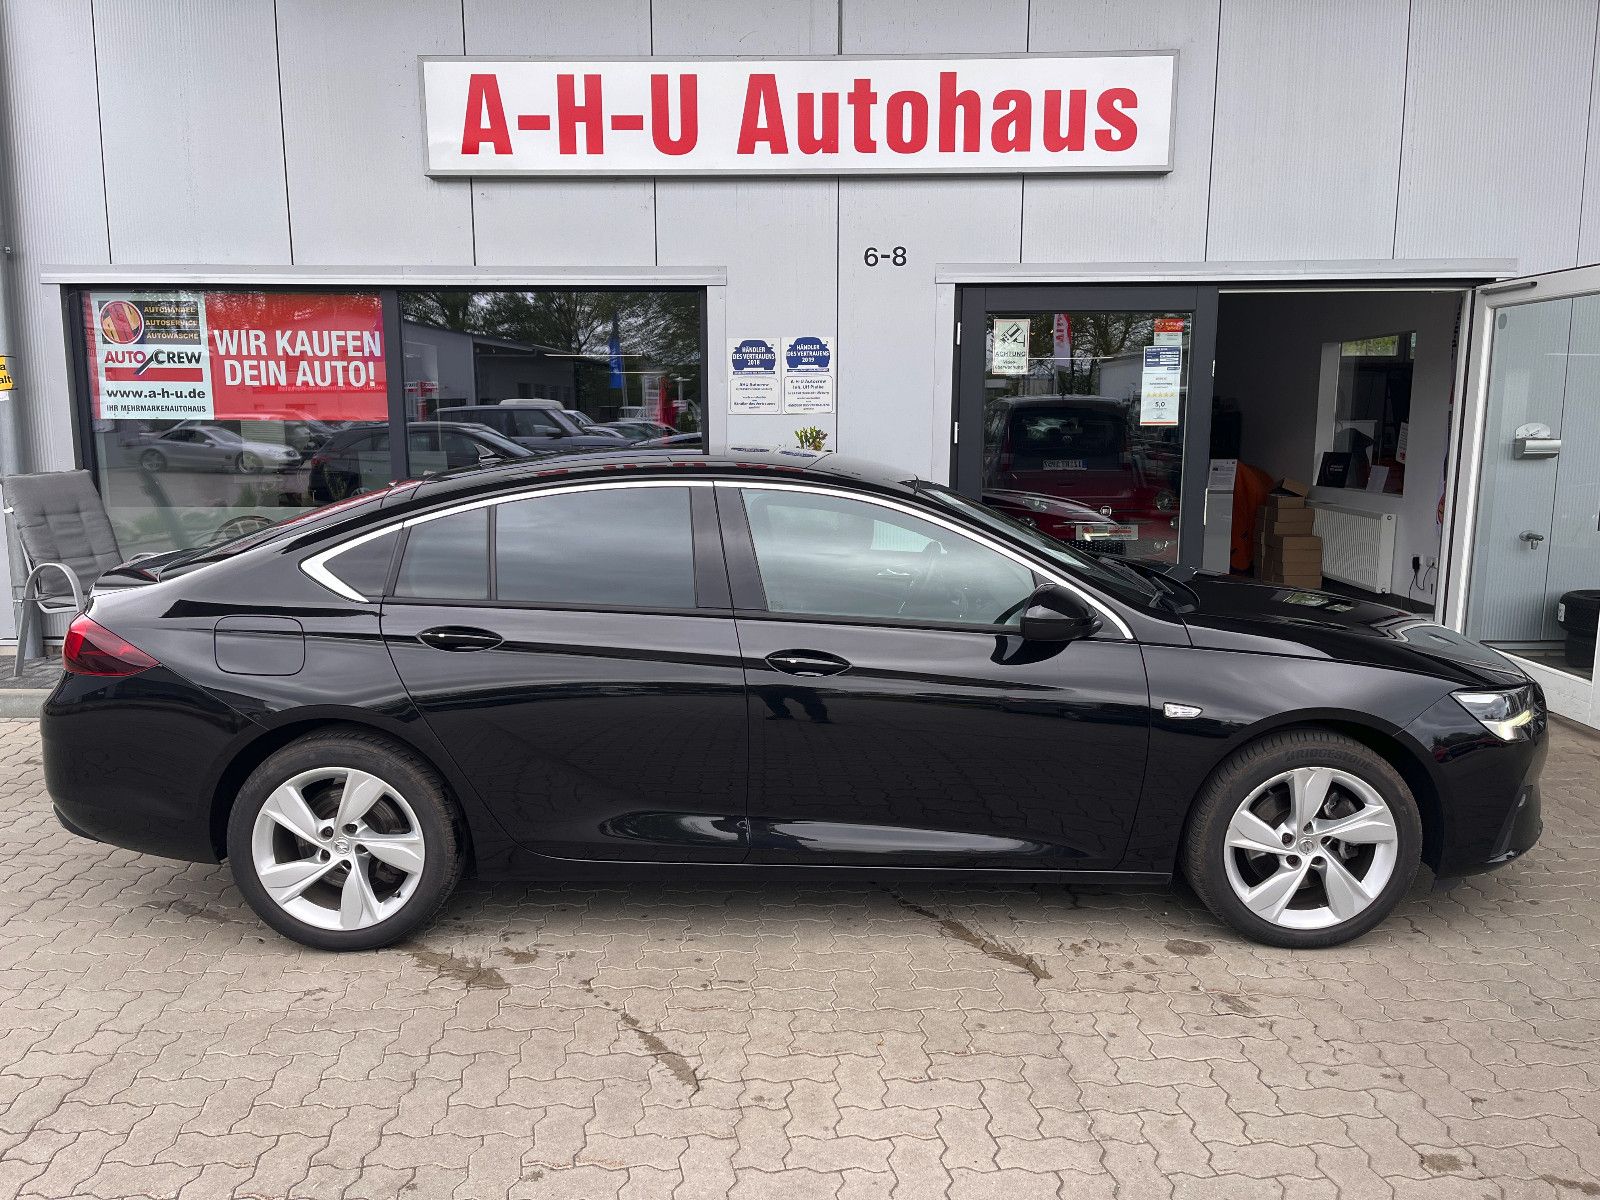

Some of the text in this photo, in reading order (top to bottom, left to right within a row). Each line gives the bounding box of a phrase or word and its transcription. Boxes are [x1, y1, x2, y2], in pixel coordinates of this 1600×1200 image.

[461, 71, 1138, 156] A-H-U Autohaus
[864, 246, 907, 267] 6-8
[212, 329, 382, 357] WIR KAUFEN
[741, 345, 766, 353] HÄNDLER
[796, 343, 820, 351] HÄNDLER
[104, 349, 202, 365] AUTO CREW
[995, 350, 1026, 358] ACHTUNG
[223, 359, 287, 386] DEIN
[295, 360, 376, 387] AUTO!
[106, 388, 206, 399] www.a-h-u.de
[106, 404, 119, 412] IHR
